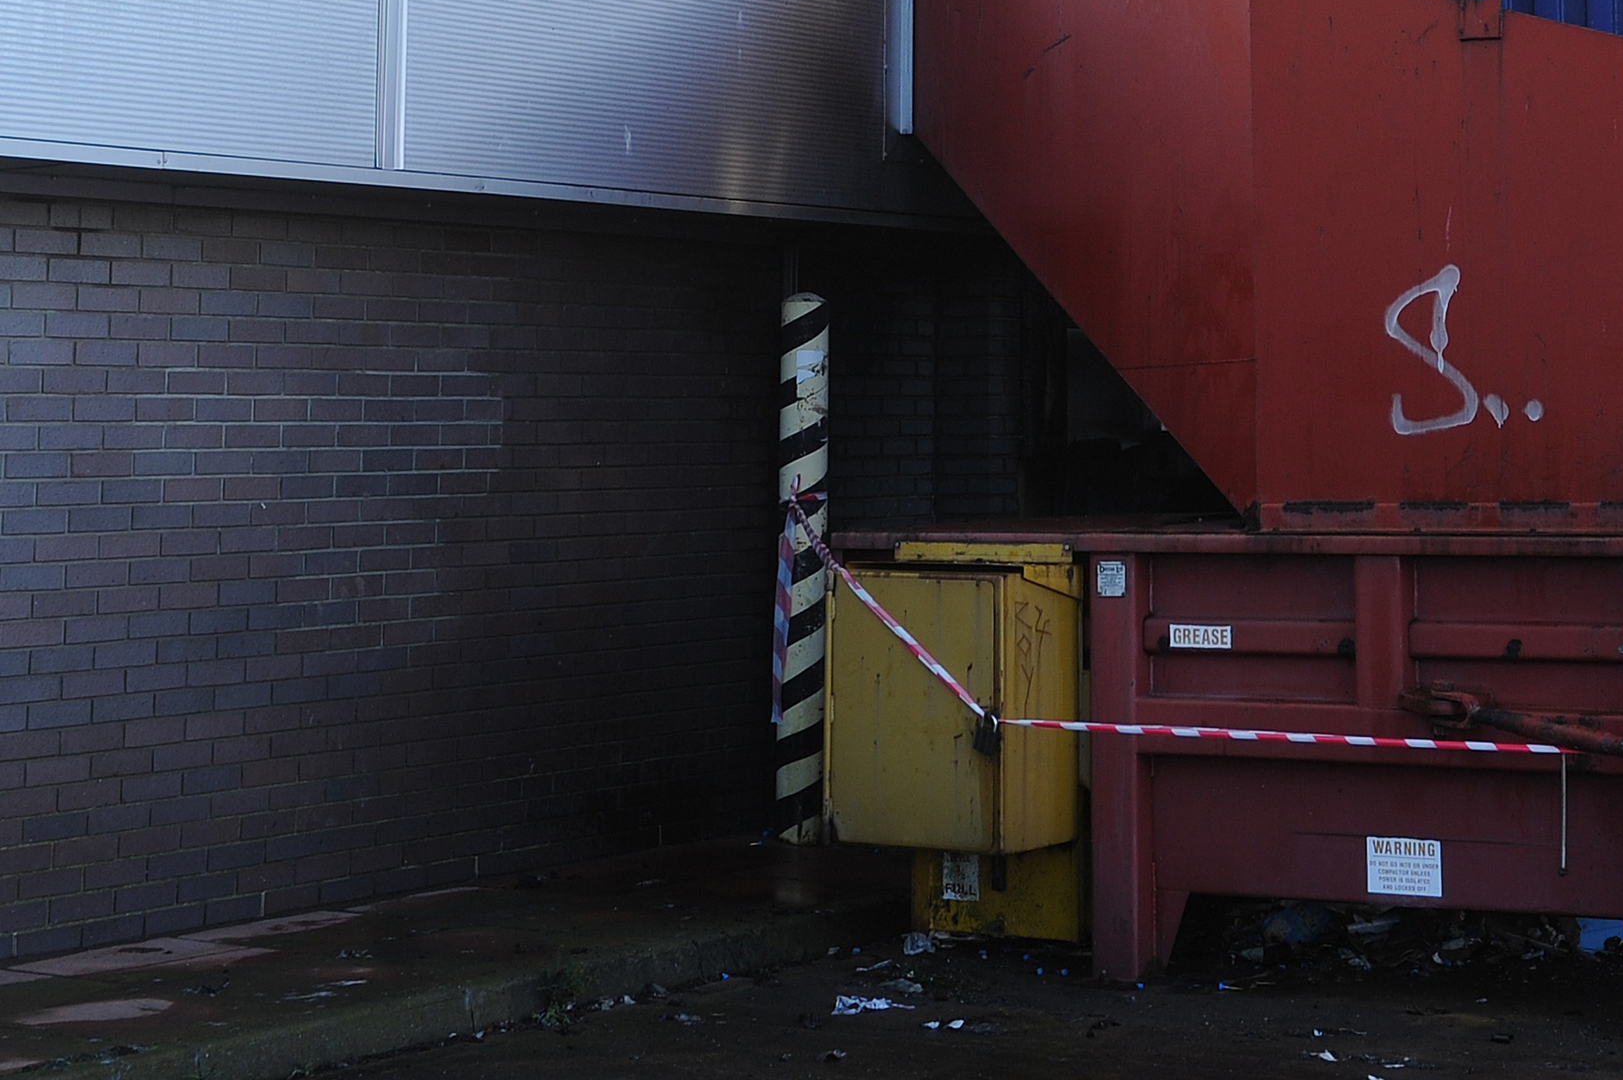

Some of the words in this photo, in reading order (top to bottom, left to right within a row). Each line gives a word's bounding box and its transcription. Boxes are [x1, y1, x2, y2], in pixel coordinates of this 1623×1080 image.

[1173, 627, 1228, 646] GREASE
[1372, 839, 1435, 857] WARNING
[945, 883, 977, 897] FULL
